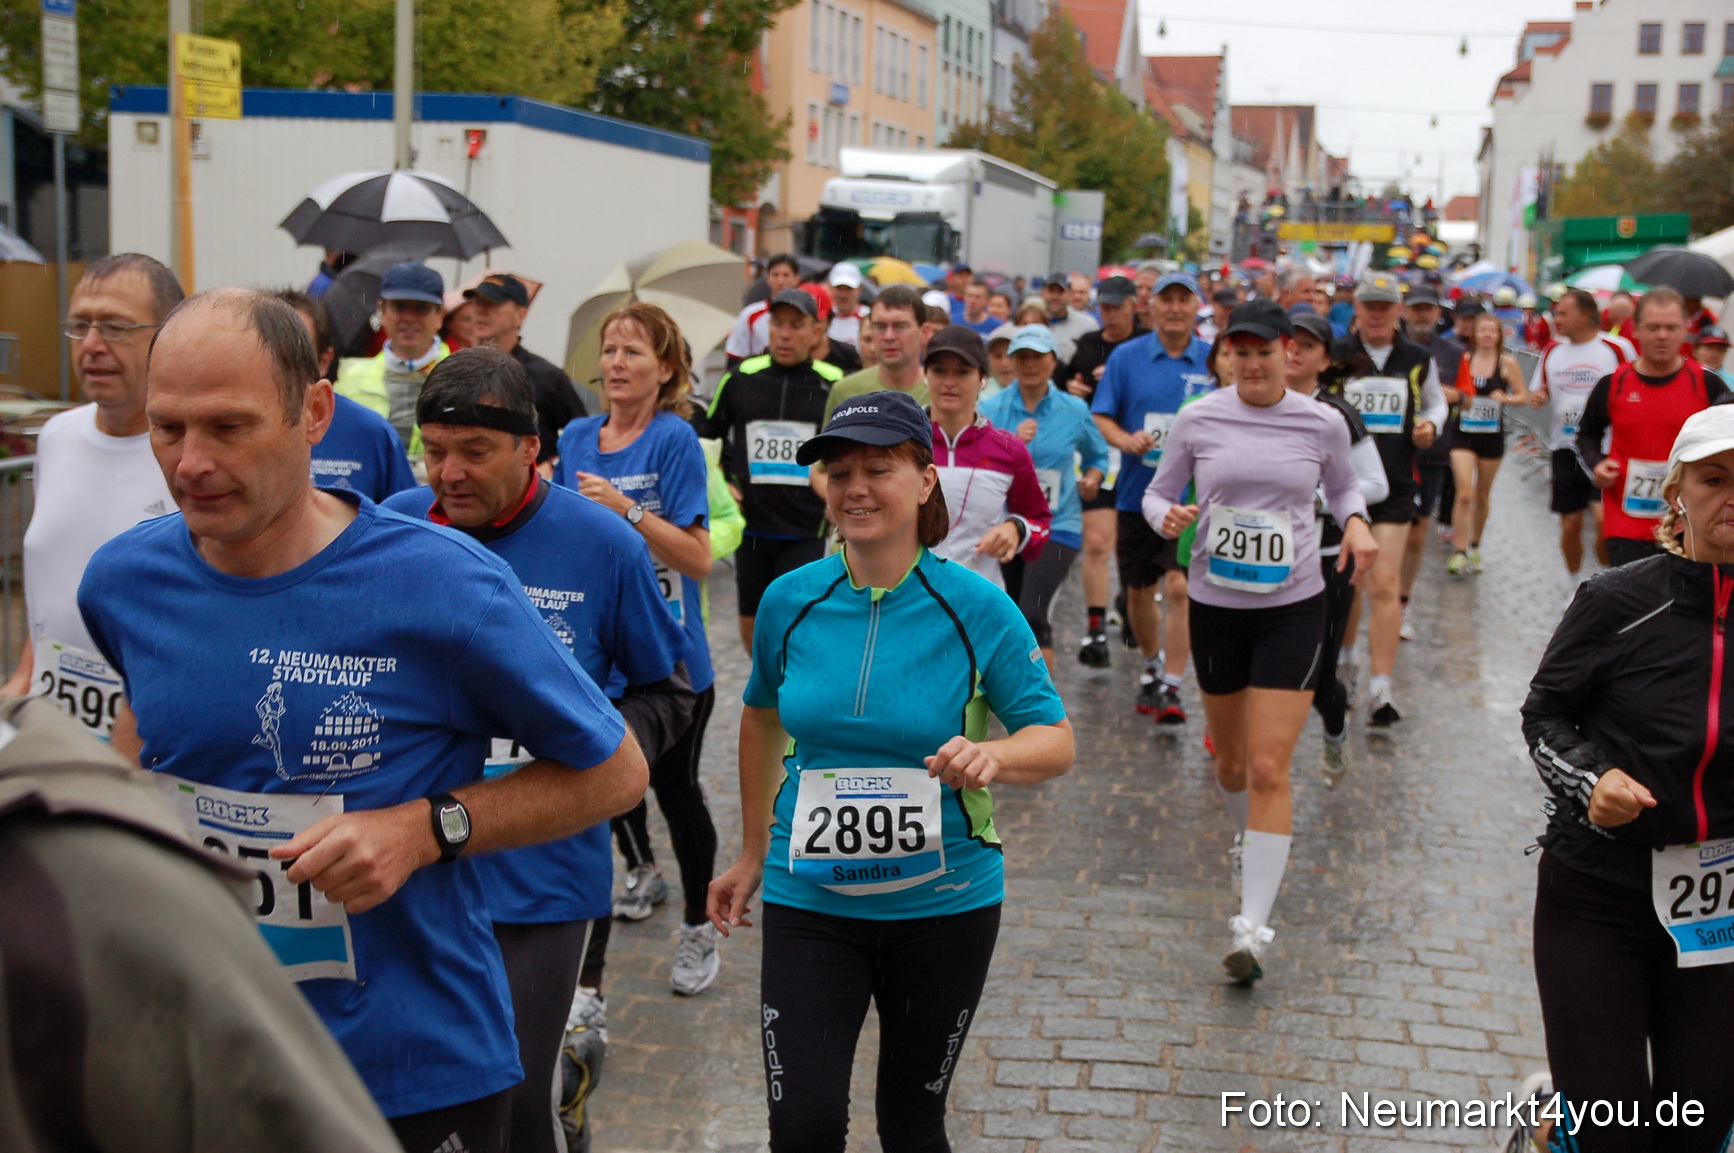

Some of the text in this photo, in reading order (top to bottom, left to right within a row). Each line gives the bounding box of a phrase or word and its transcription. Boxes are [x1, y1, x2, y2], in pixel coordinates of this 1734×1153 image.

[1353, 393, 1400, 412] 2870
[1215, 527, 1284, 562] 2910
[522, 586, 585, 602] UMARKTER
[530, 598, 569, 611] TLAUF
[249, 648, 397, 672] 12. NEUMARKTER
[272, 665, 372, 687] STADTLAUF
[310, 734, 380, 751] 18.09.2011
[835, 777, 892, 790] BOCK
[196, 796, 270, 826] BOCK
[805, 805, 926, 855] 2895
[832, 863, 902, 882] Sandra
[940, 1008, 968, 1074] odlo
[766, 1030, 783, 1101] odlo
